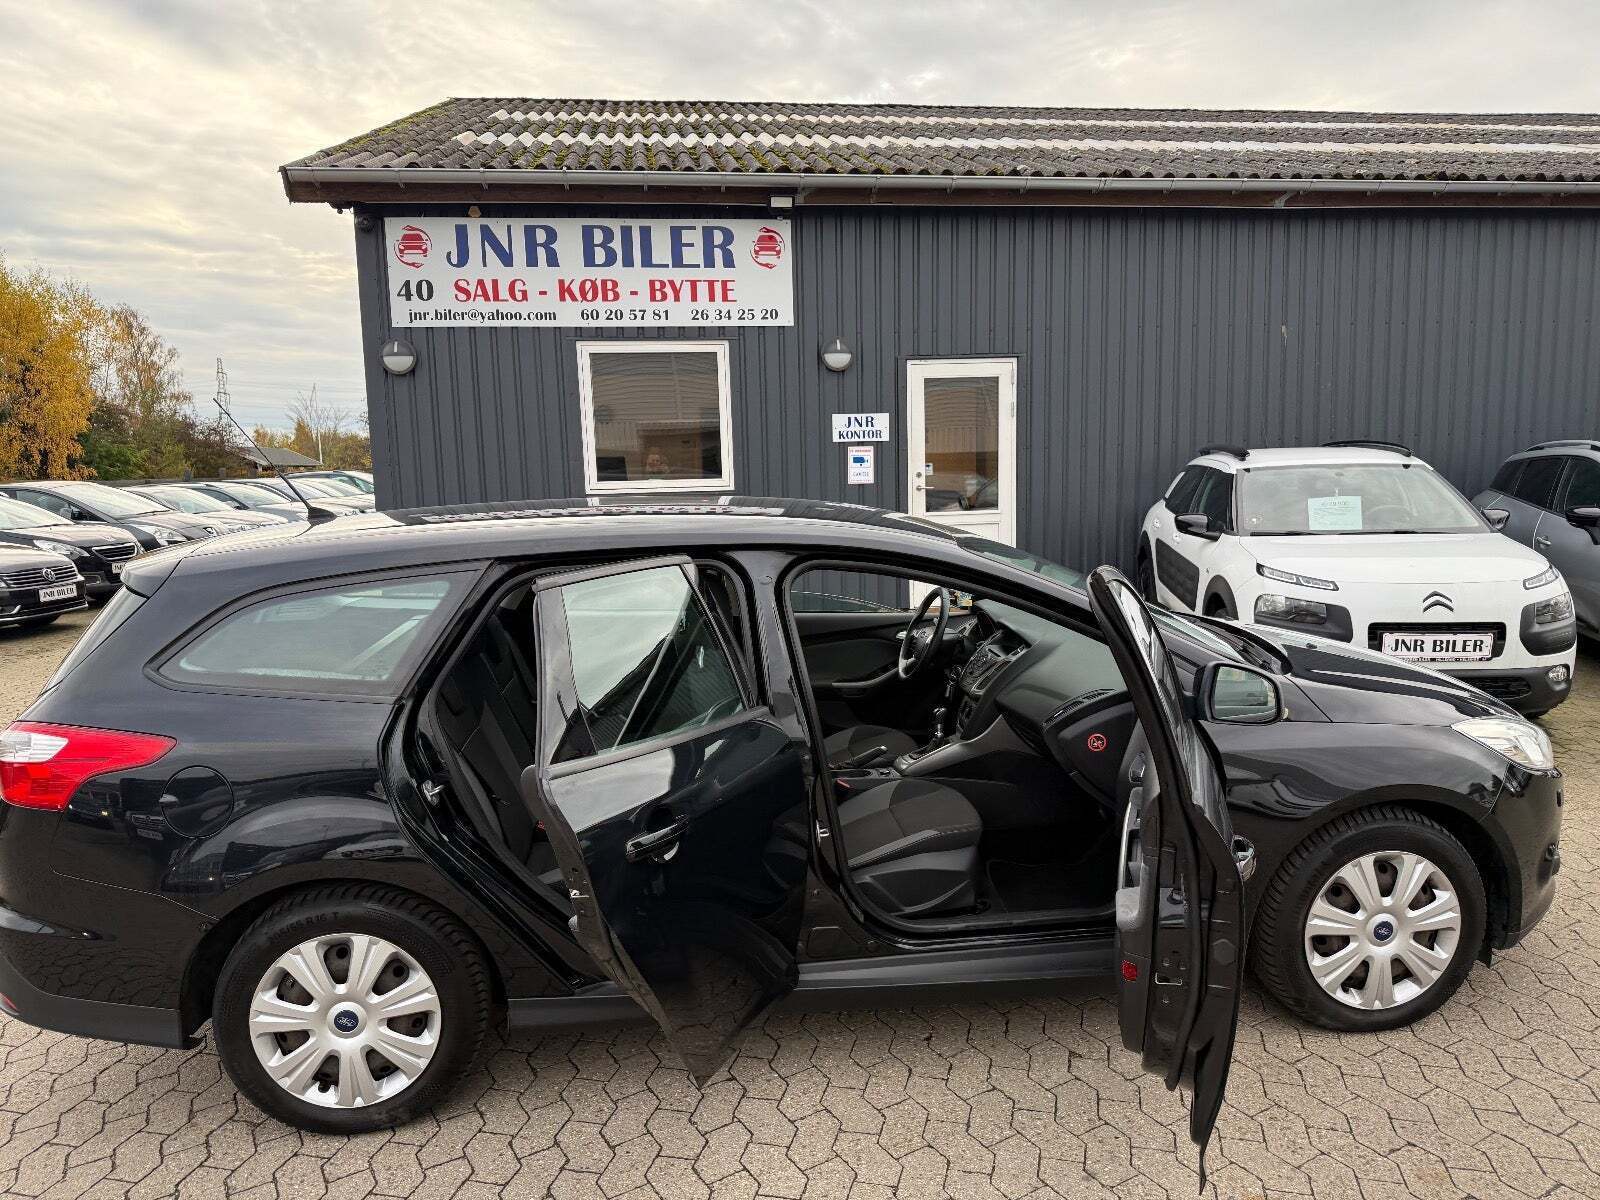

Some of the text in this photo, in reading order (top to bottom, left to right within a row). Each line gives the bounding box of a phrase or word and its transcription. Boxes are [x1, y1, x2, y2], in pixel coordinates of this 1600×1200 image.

[446, 223, 736, 269] JNR BILER
[396, 279, 434, 302] 40
[453, 278, 529, 303] SALG
[557, 278, 620, 304] KØB
[649, 279, 737, 303] BYTTE
[408, 308, 557, 323] jnr.biler@yahoo.com
[580, 308, 670, 321] 60 20 57 81
[691, 308, 779, 321] 26 34 25 20
[845, 416, 875, 428] JNR
[838, 430, 882, 440] KONTOR
[43, 587, 74, 598] JNR BILER
[1390, 638, 1484, 653] JNR BILER
